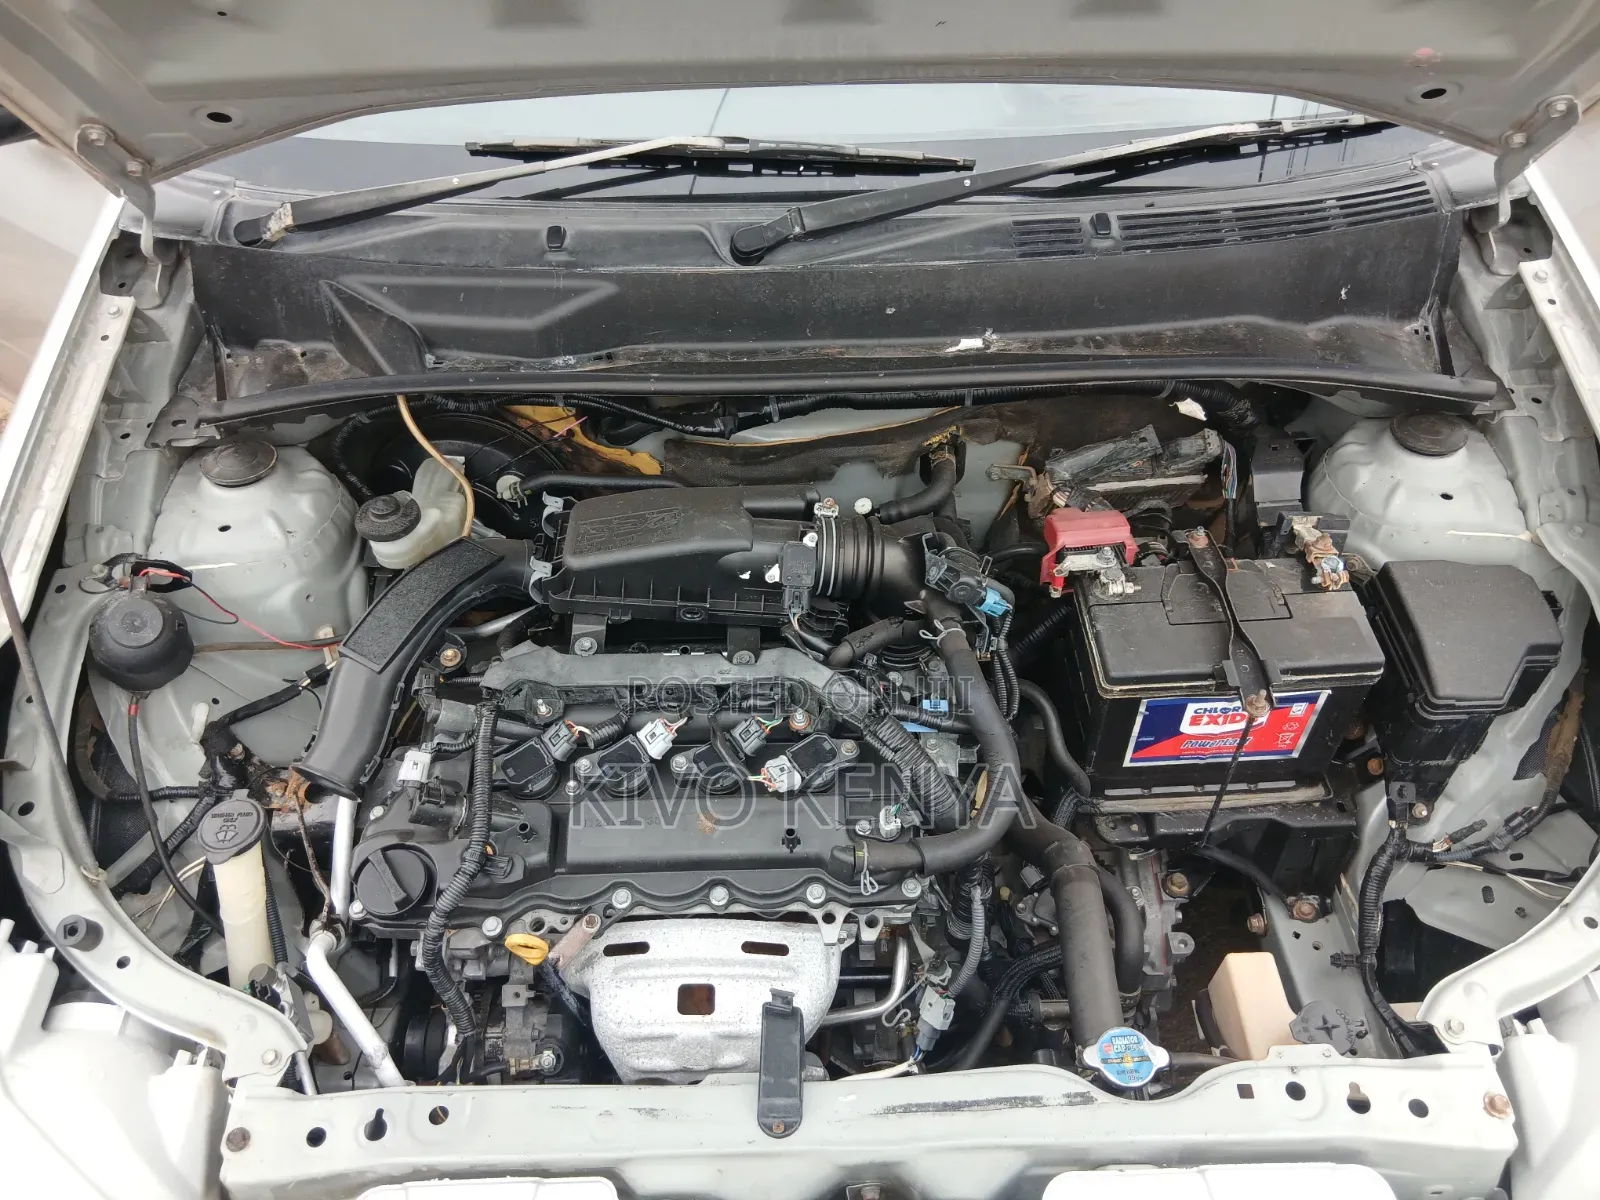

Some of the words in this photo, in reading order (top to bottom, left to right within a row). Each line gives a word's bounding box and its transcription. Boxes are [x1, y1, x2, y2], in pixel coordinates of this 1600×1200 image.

[1188, 712, 1258, 727] EXID
[1111, 1036, 1139, 1045] RADIATOR
[1113, 1044, 1126, 1053] CAP
